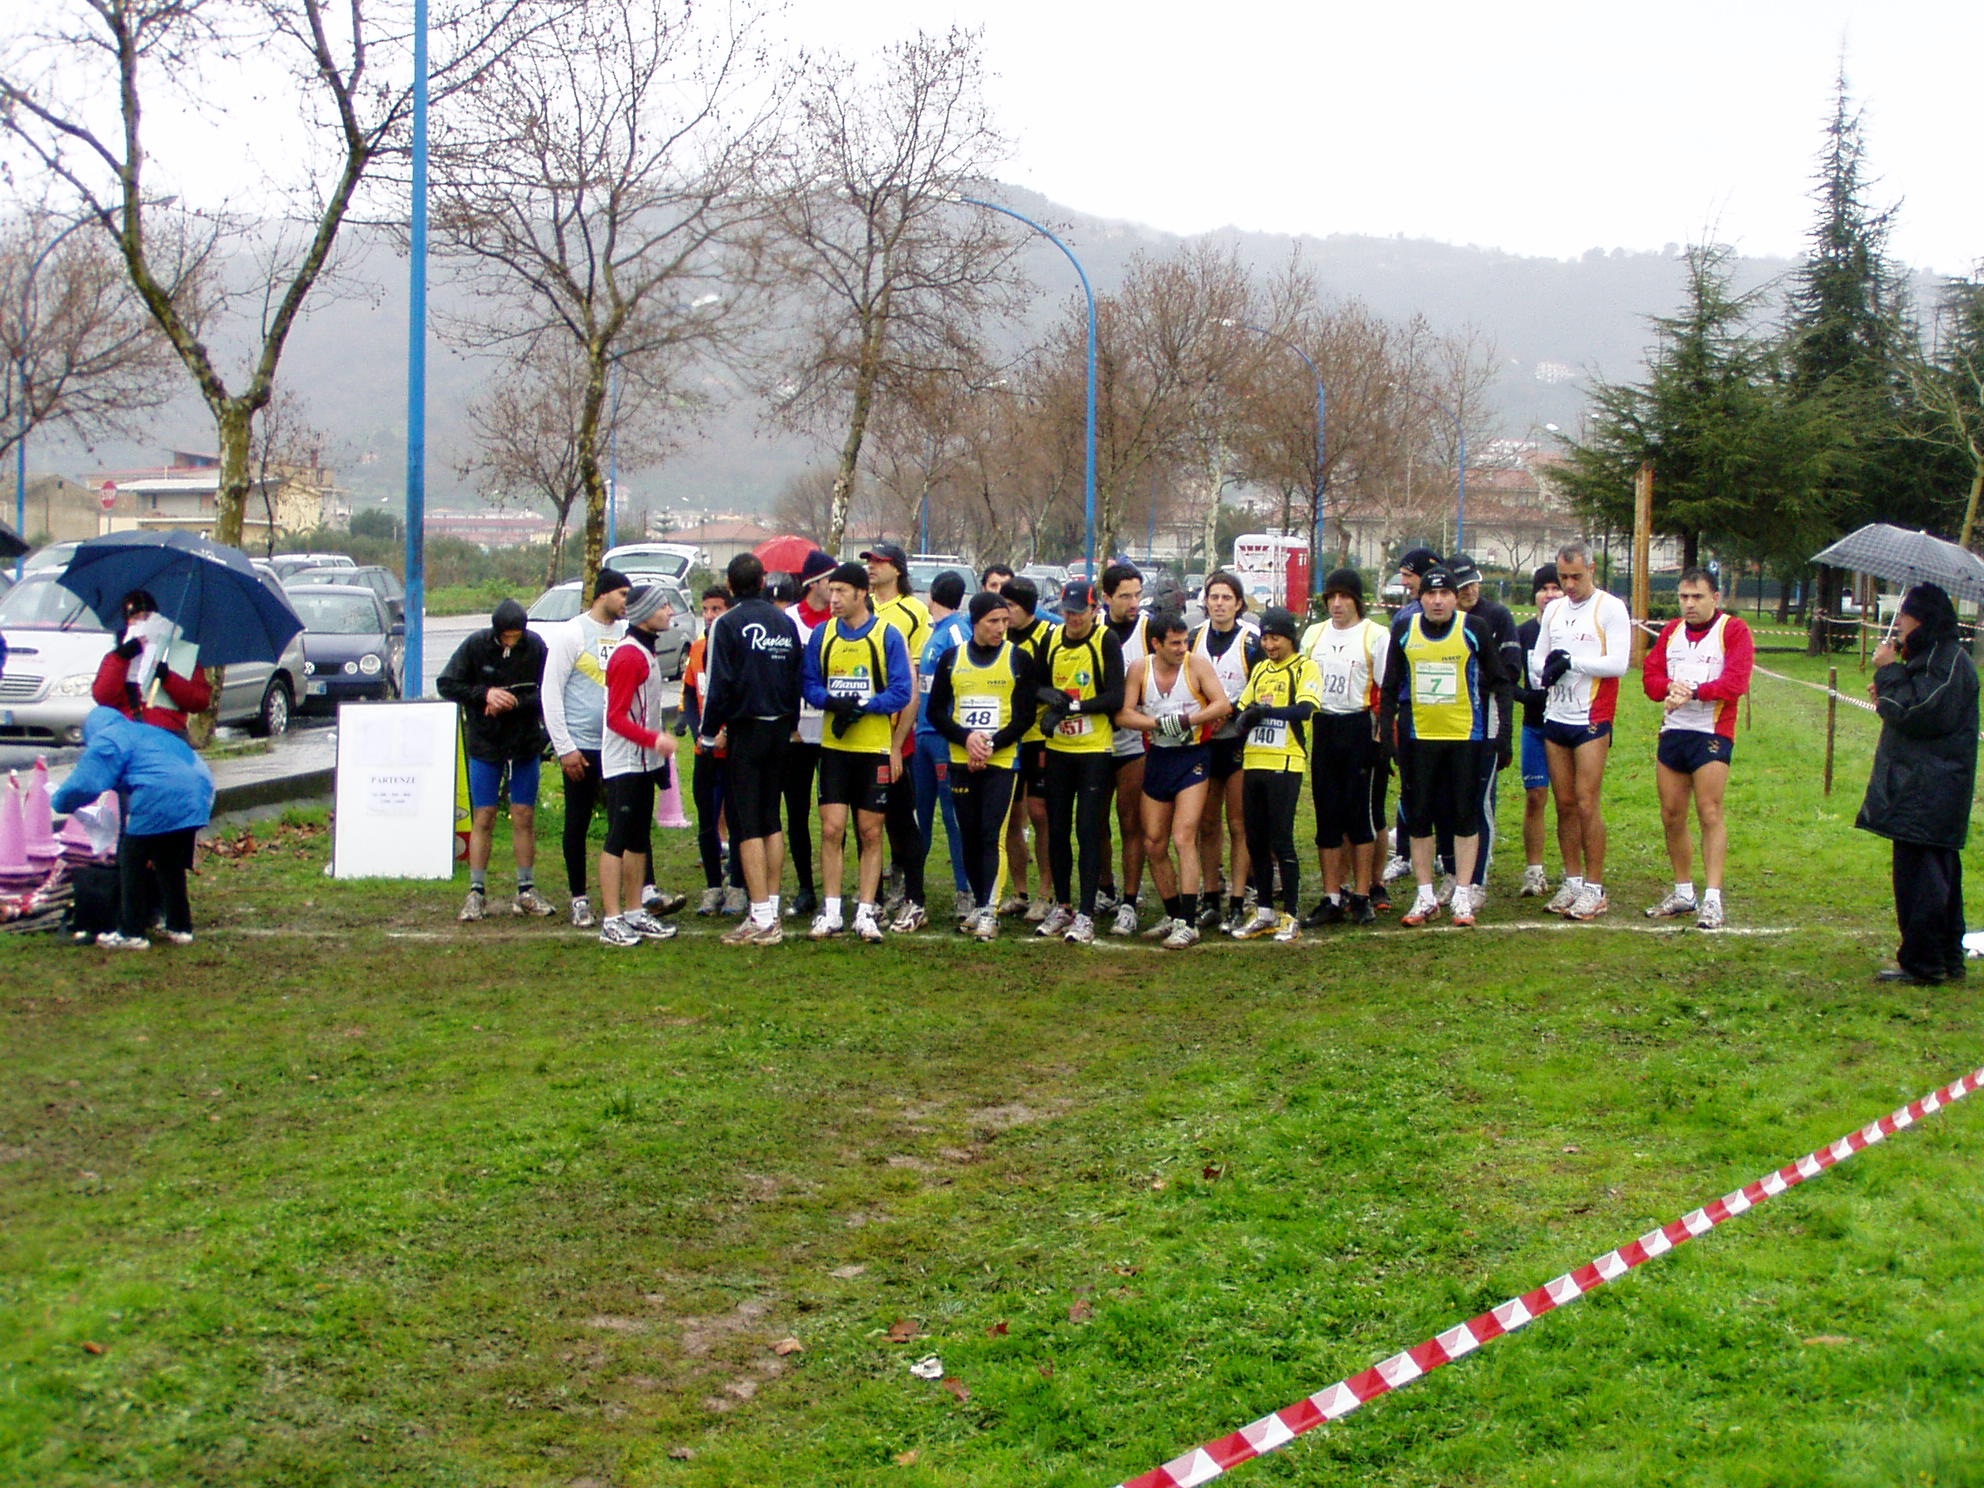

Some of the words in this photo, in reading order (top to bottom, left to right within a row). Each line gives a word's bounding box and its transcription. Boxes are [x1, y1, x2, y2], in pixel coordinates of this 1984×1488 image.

[102, 489, 116, 500] STOP
[1430, 679, 1442, 693] 7
[965, 711, 991, 725] 48
[1254, 729, 1275, 744] 140
